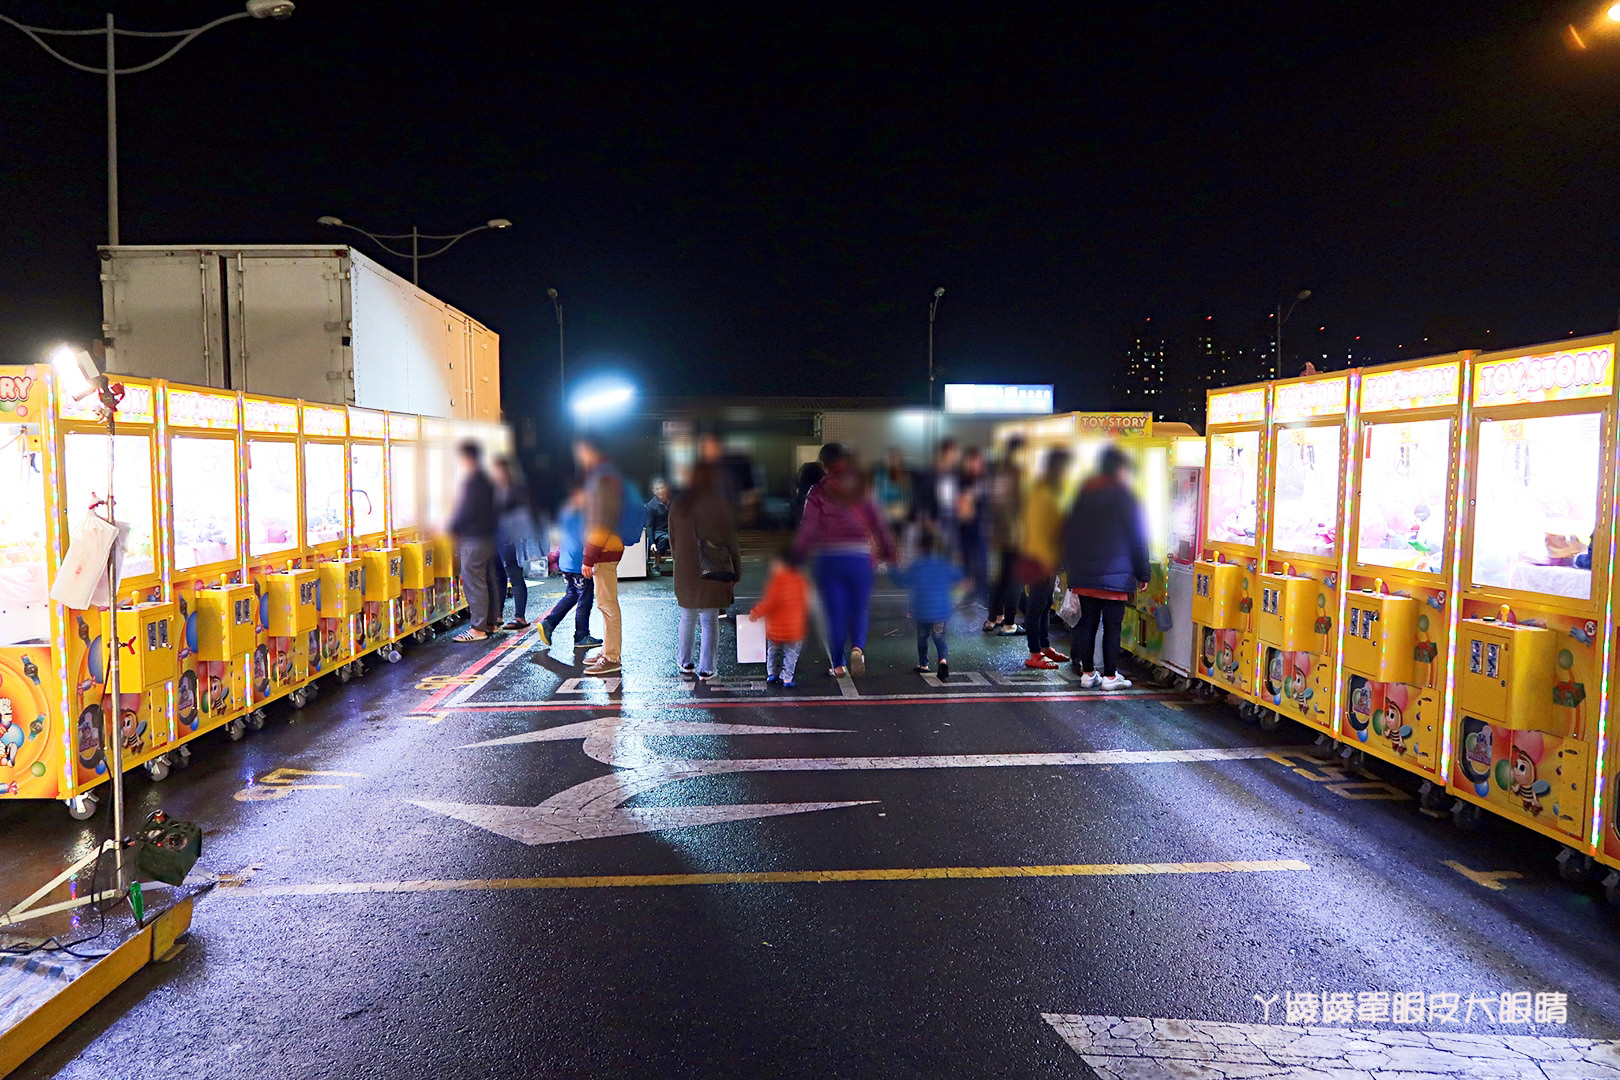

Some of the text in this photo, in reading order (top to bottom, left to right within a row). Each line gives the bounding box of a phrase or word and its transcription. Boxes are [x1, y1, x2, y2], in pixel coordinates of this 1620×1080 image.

[1398, 366, 1456, 401] STORY
[1482, 349, 1608, 397] TOY STORY
[1081, 416, 1148, 428] TOY STORY
